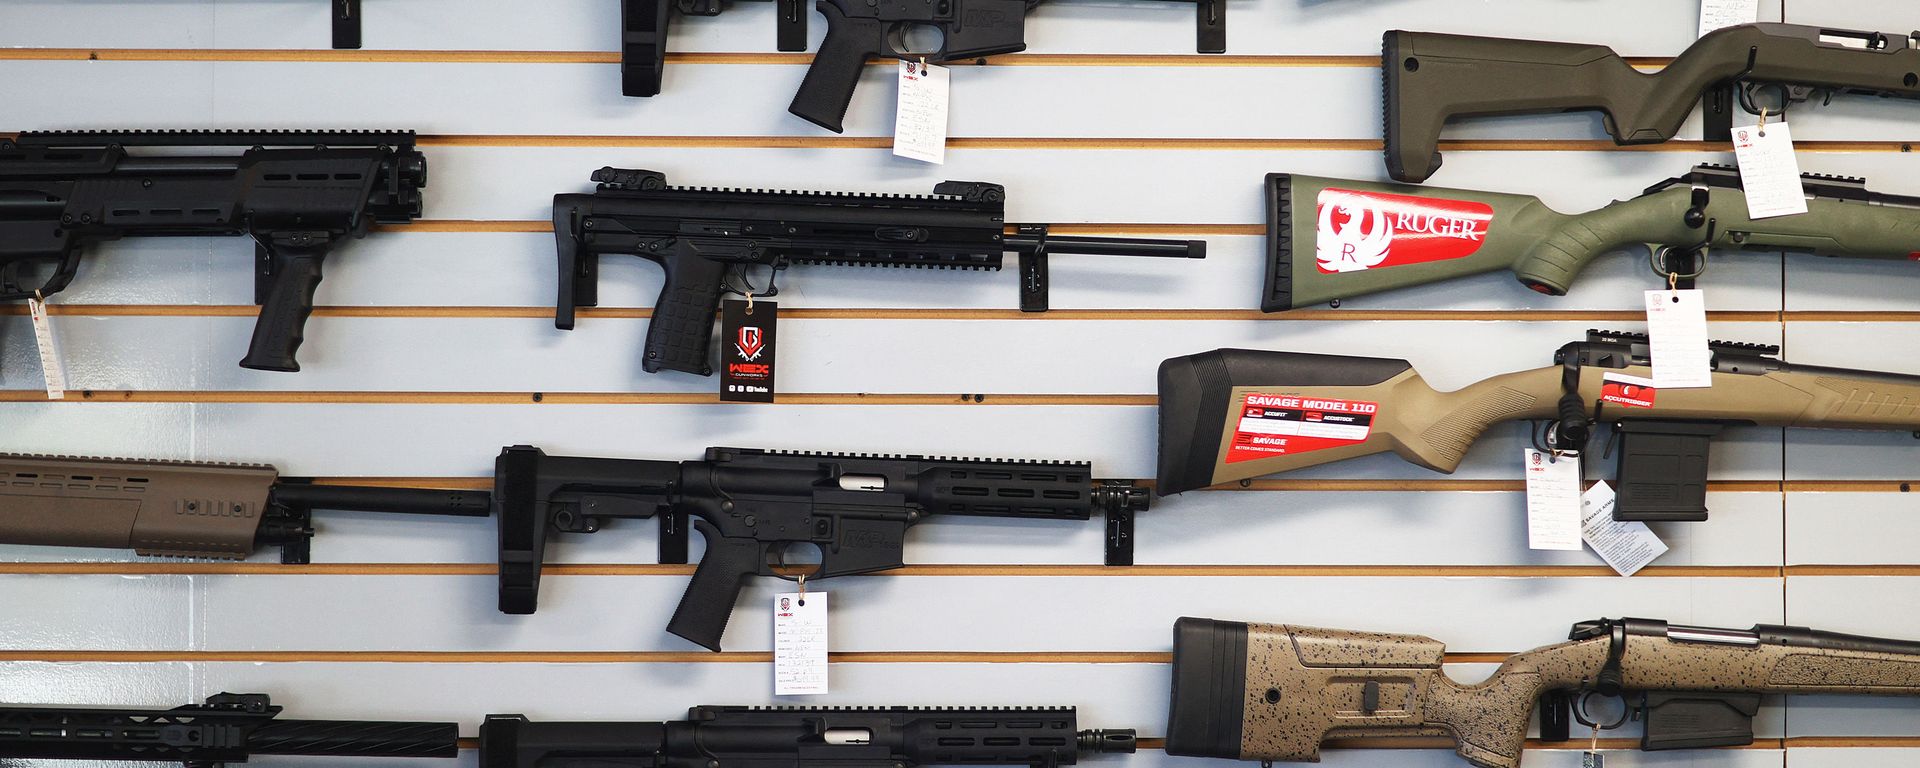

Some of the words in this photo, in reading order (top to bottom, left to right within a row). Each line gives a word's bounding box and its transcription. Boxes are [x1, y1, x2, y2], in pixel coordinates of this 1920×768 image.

[1395, 211, 1479, 241] RUGER
[1341, 243, 1356, 263] R
[729, 363, 769, 374] WEX
[1247, 396, 1299, 408] SAVAGE
[1302, 400, 1348, 411] MODEL
[1352, 403, 1376, 413] 110
[1603, 394, 1652, 406] ACCUTRIGGER
[1253, 437, 1288, 446] SAVAGE
